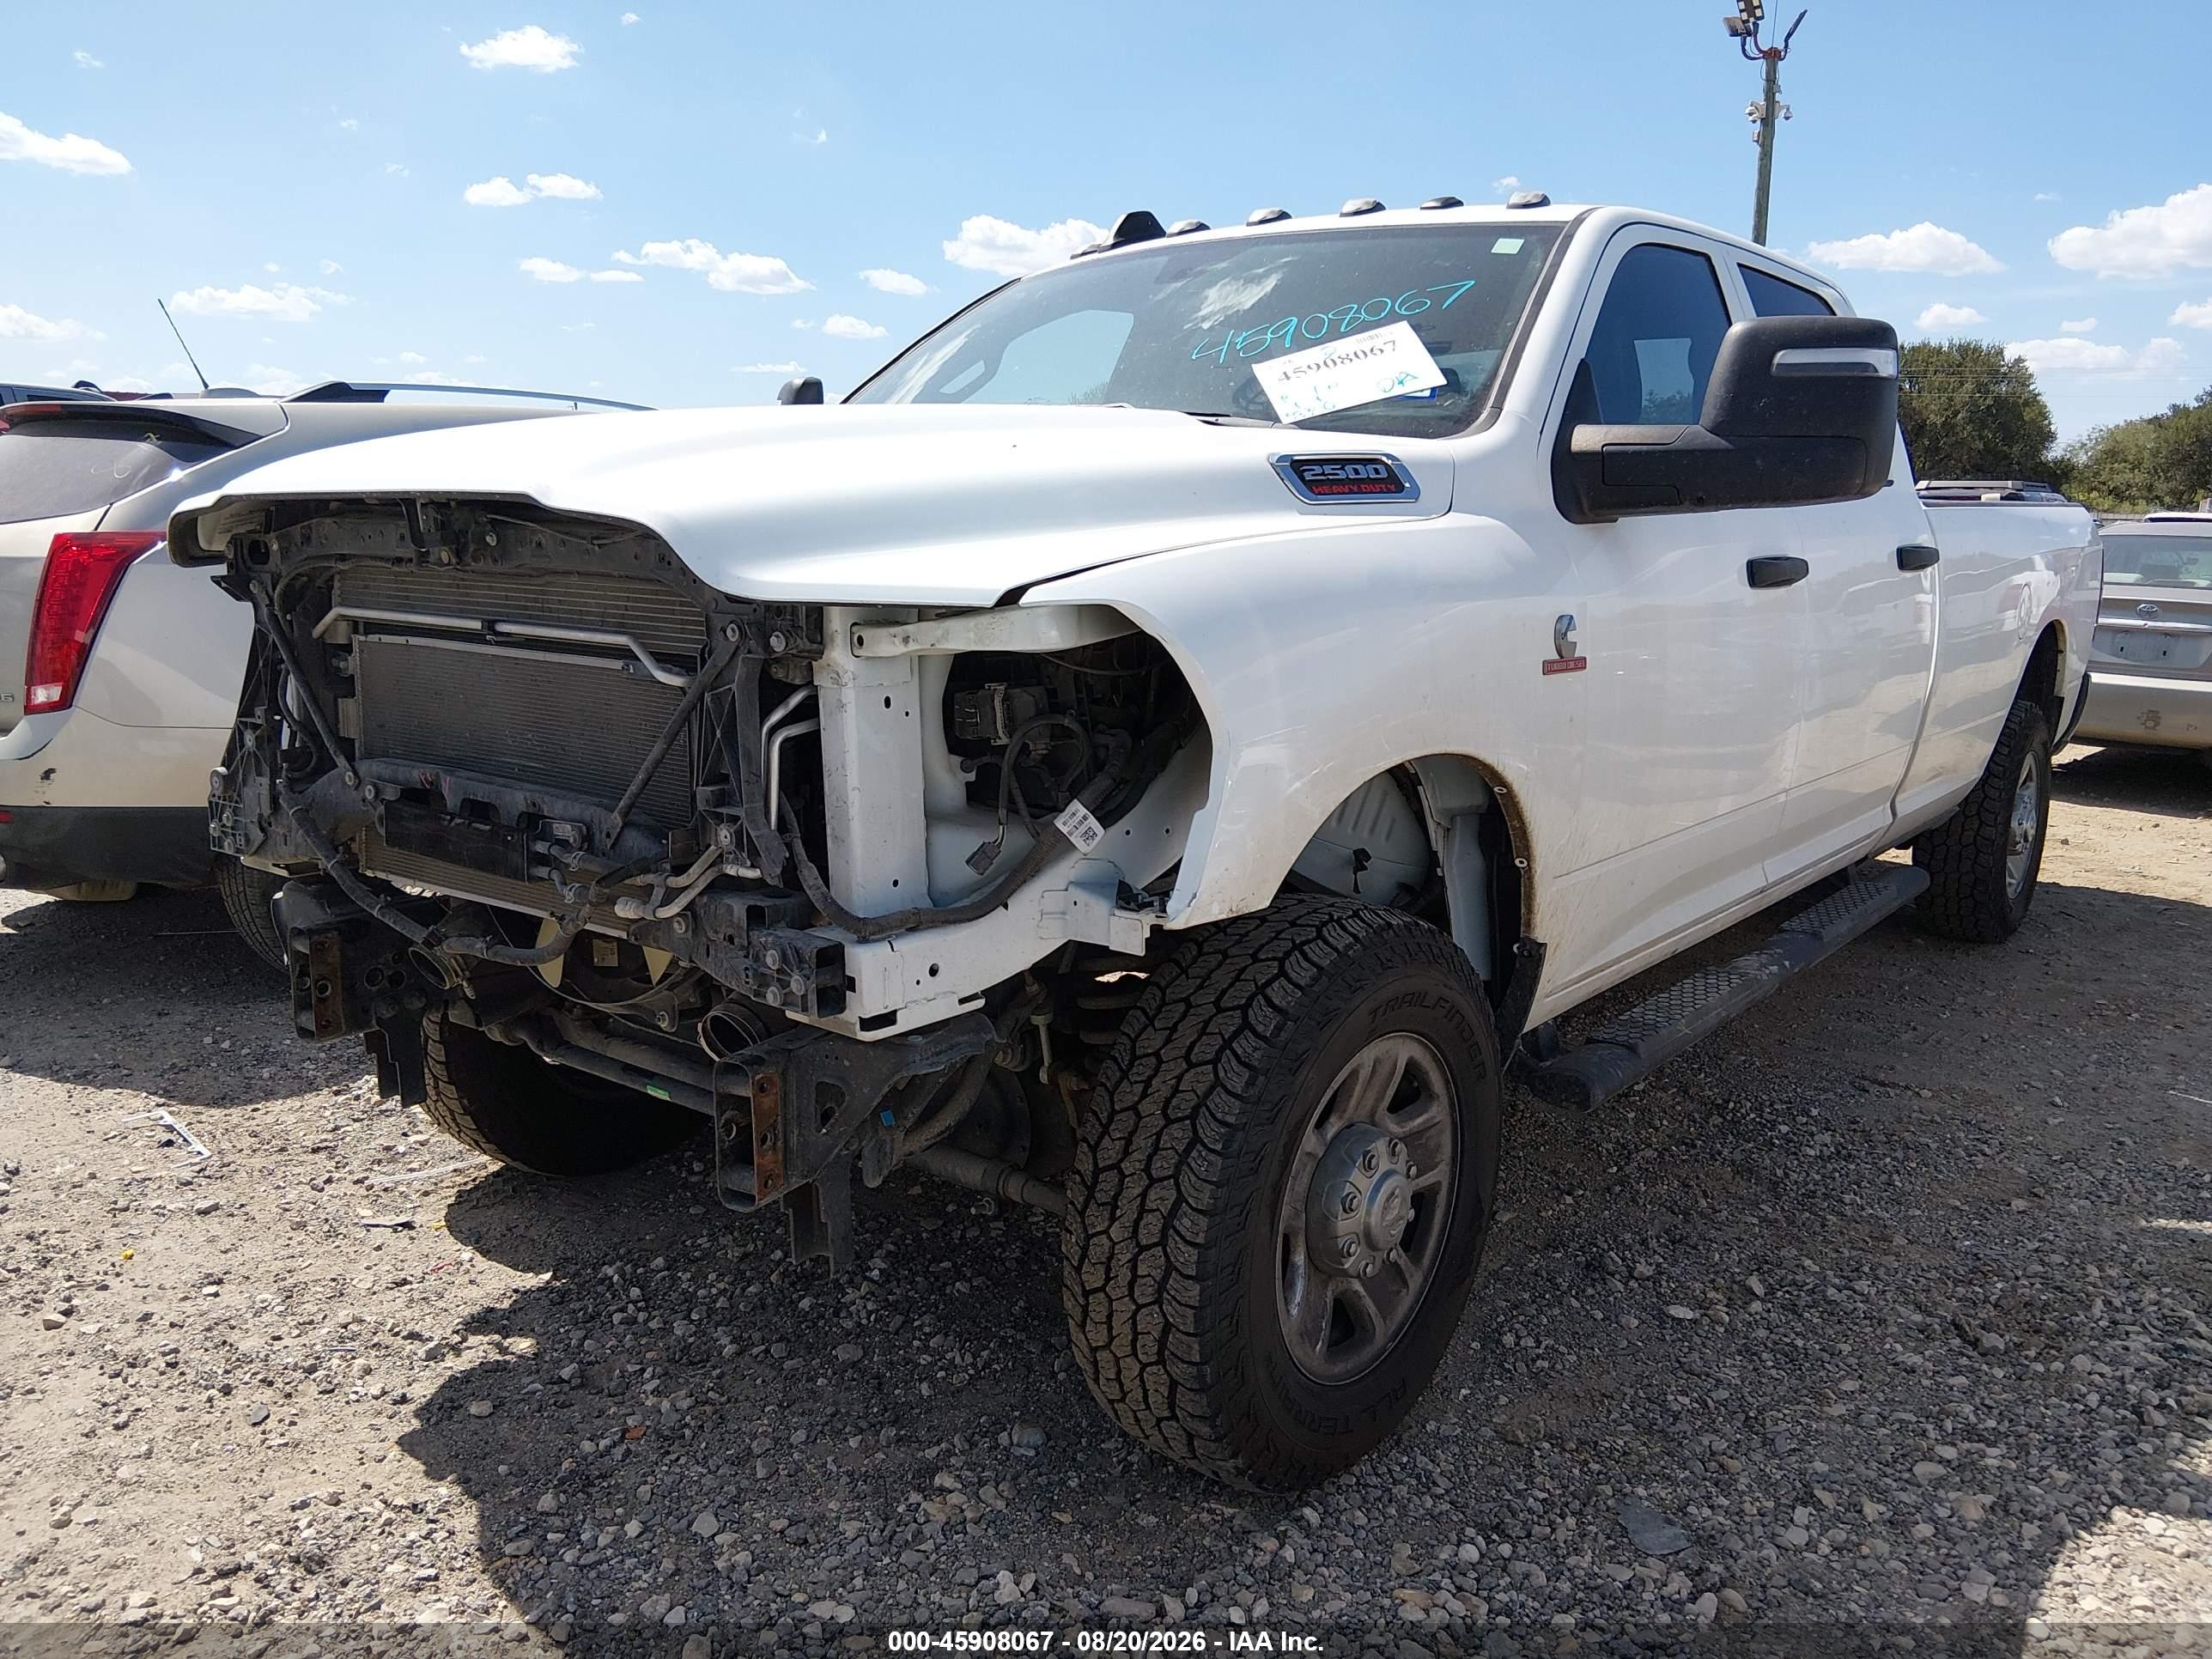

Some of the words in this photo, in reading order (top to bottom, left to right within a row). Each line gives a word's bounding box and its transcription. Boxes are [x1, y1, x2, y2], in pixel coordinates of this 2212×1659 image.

[1190, 279, 1476, 363] 45908067
[1278, 339, 1397, 382] 45908067
[1299, 464, 1389, 480] 2500
[1311, 484, 1358, 494] HEAVY
[1359, 483, 1395, 492] DUTY
[1369, 991, 1488, 1081] TRAILFINDER
